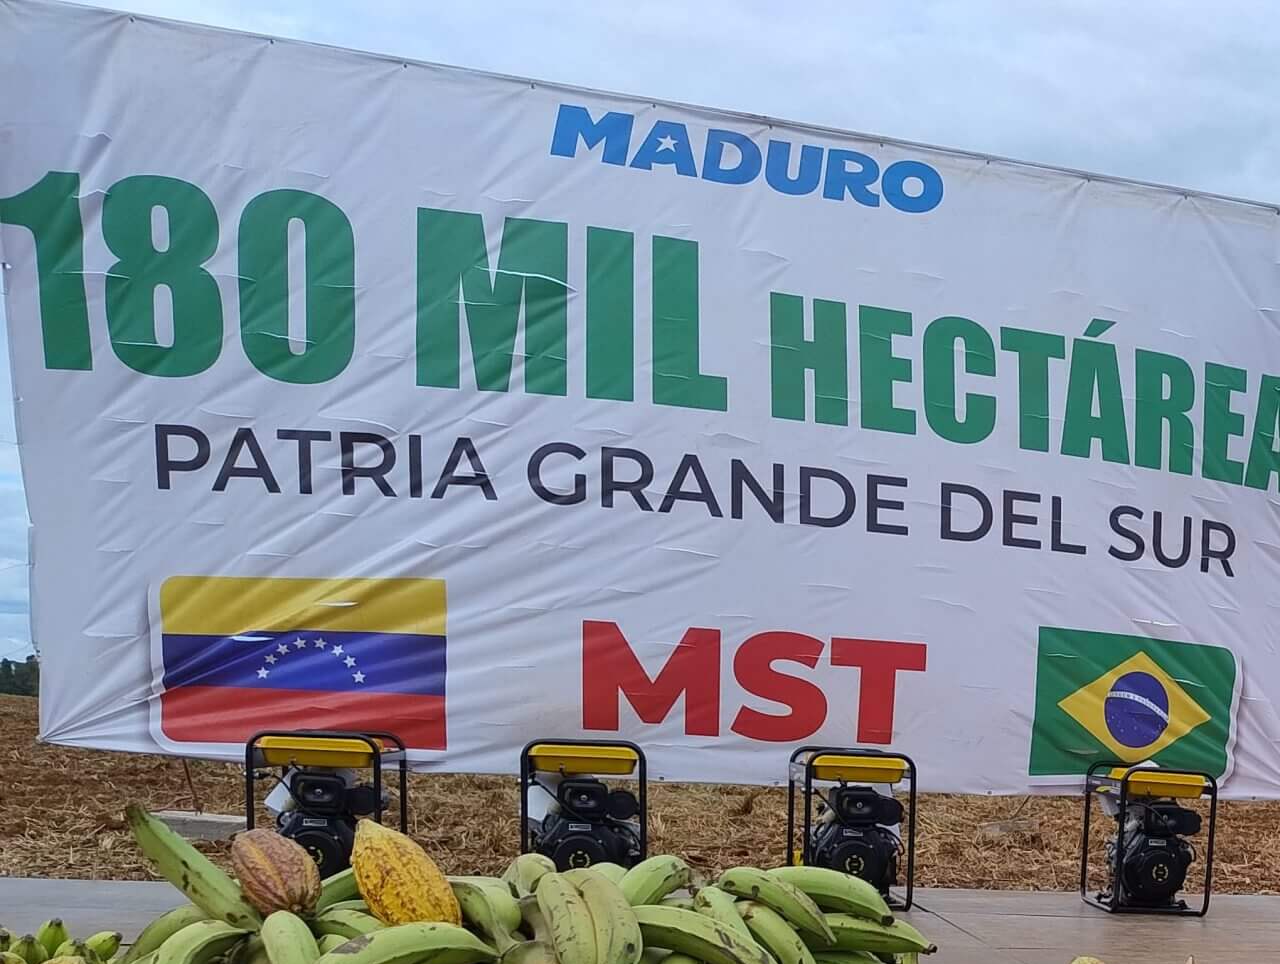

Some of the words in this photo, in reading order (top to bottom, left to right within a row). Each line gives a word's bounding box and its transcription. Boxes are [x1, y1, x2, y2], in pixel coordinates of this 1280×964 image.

[550, 104, 944, 214] MADURO
[0, 171, 356, 384] 180
[416, 206, 728, 411] MIL
[154, 423, 498, 500] PATRIA
[527, 442, 909, 536] GRANDE
[940, 482, 1087, 555] DEL
[1108, 505, 1236, 578] SUR
[583, 620, 927, 744] MST
